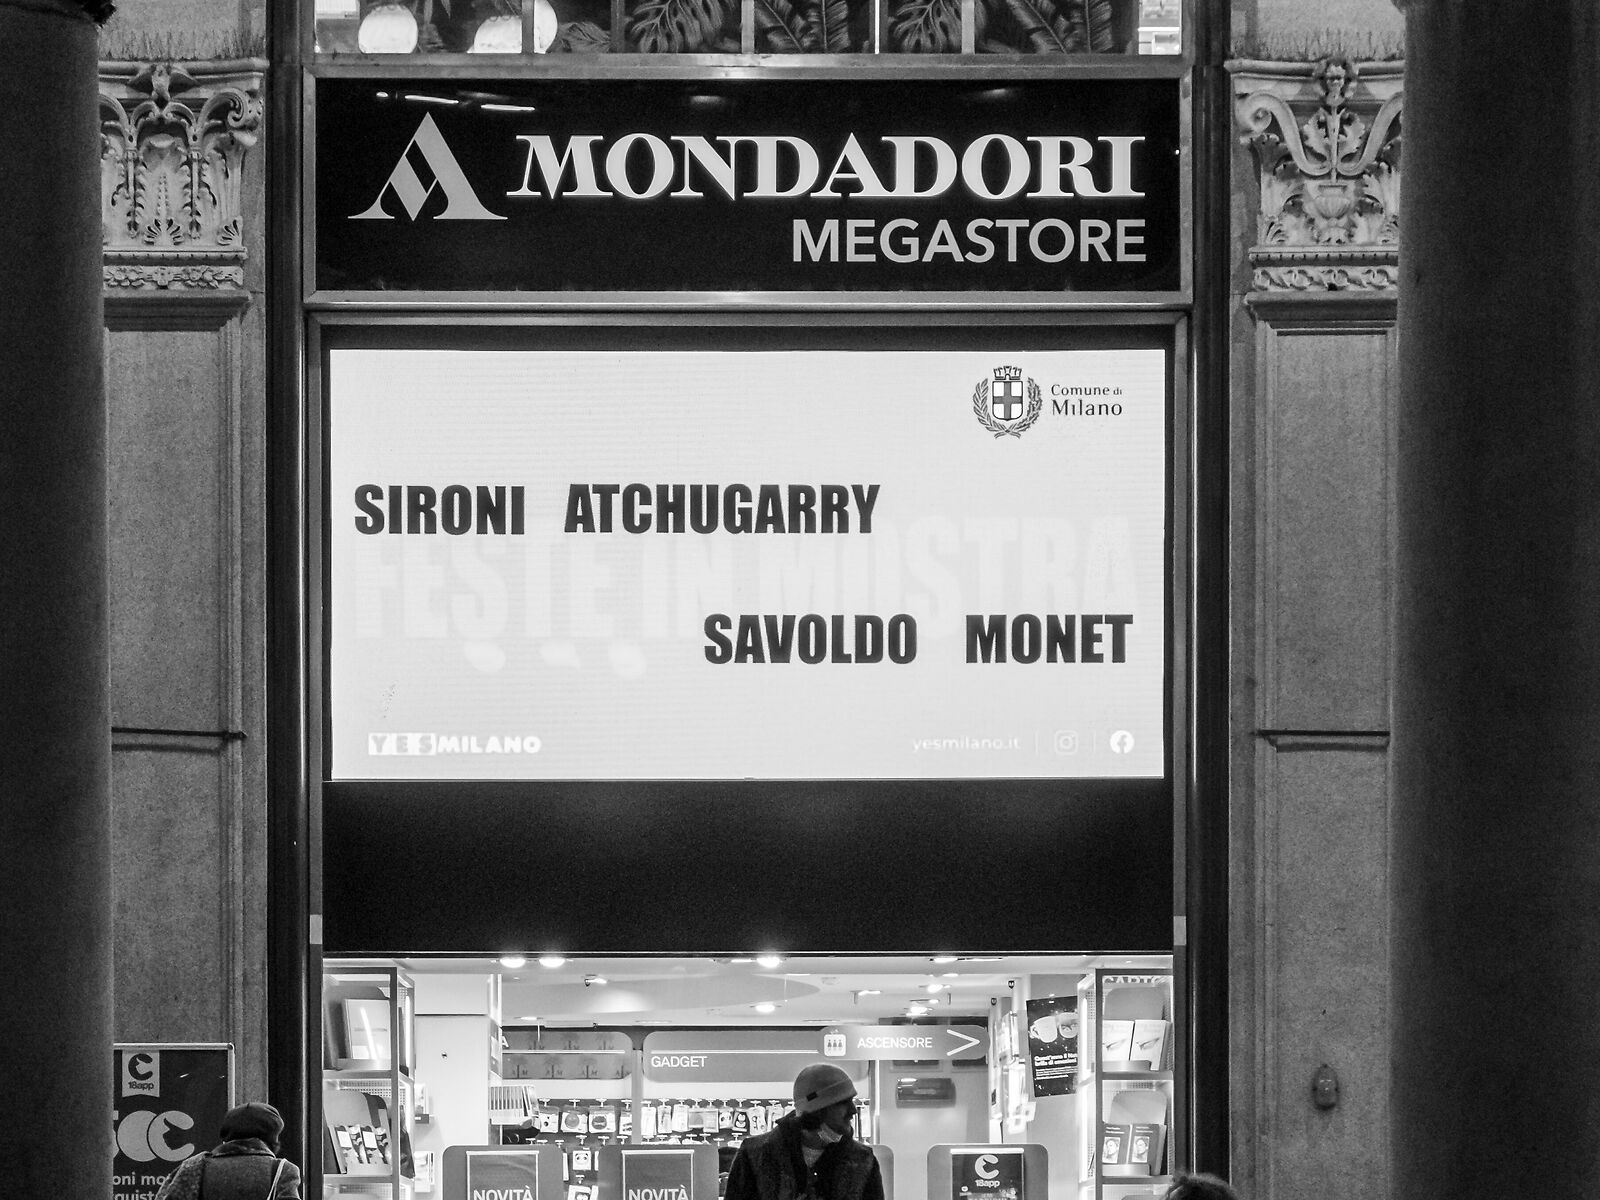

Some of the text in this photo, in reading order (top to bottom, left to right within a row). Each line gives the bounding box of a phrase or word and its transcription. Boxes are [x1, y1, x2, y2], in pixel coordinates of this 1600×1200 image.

[506, 132, 1146, 199] MONDADORI
[792, 219, 1147, 264] MEGASTORE
[1051, 384, 1123, 396] Comune di
[1051, 398, 1123, 416] Milano
[354, 483, 880, 536] SIRONI ATCHUGARRY
[704, 613, 1134, 664] SAVOLDO MONET
[911, 735, 1021, 753] yesmilano.it
[857, 1037, 933, 1049] ASCENSORE
[651, 1055, 708, 1068] GADGET
[128, 1081, 155, 1090] 18app
[113, 1171, 166, 1186] oni mo
